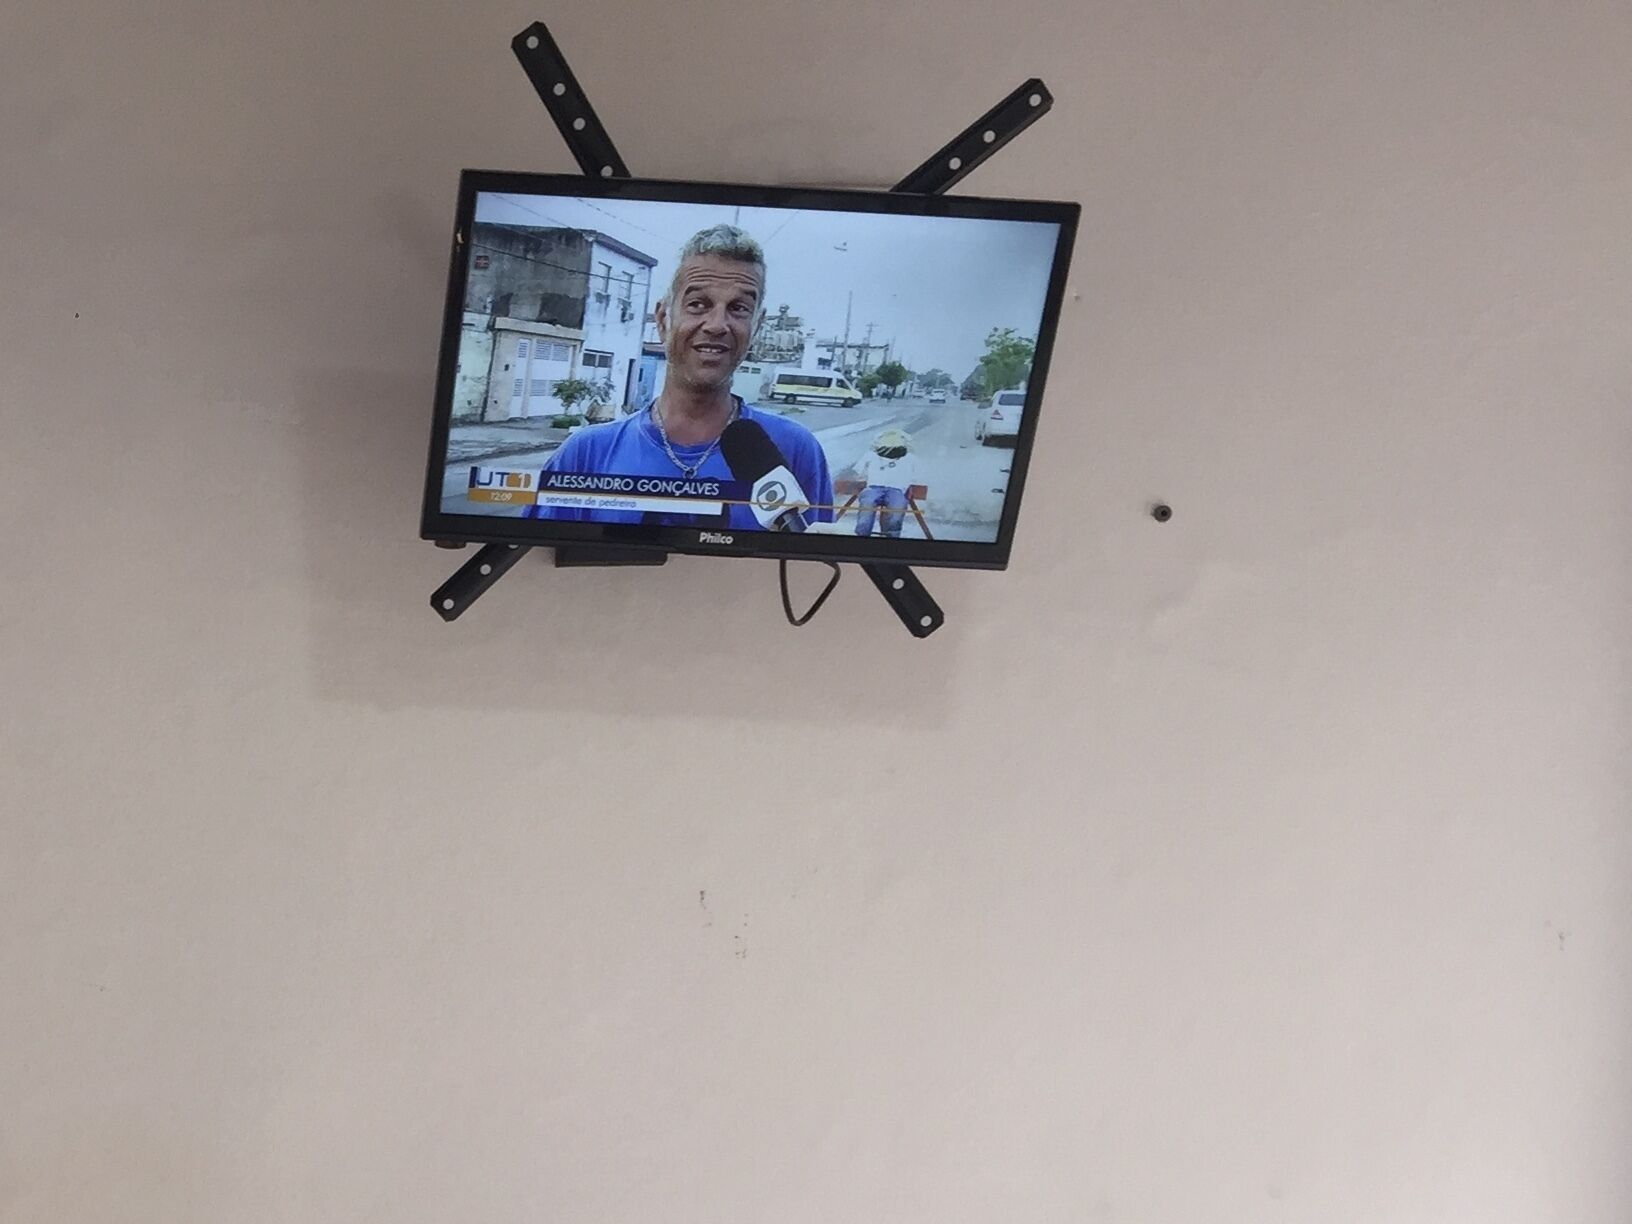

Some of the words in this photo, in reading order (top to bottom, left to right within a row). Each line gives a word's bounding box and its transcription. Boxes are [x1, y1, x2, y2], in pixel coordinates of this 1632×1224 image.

[547, 475, 634, 491] ALESSANDRO
[636, 479, 720, 496] GONÇALVES
[584, 496, 596, 505] de
[598, 499, 637, 508] pedreiro
[699, 532, 734, 544] Philco
